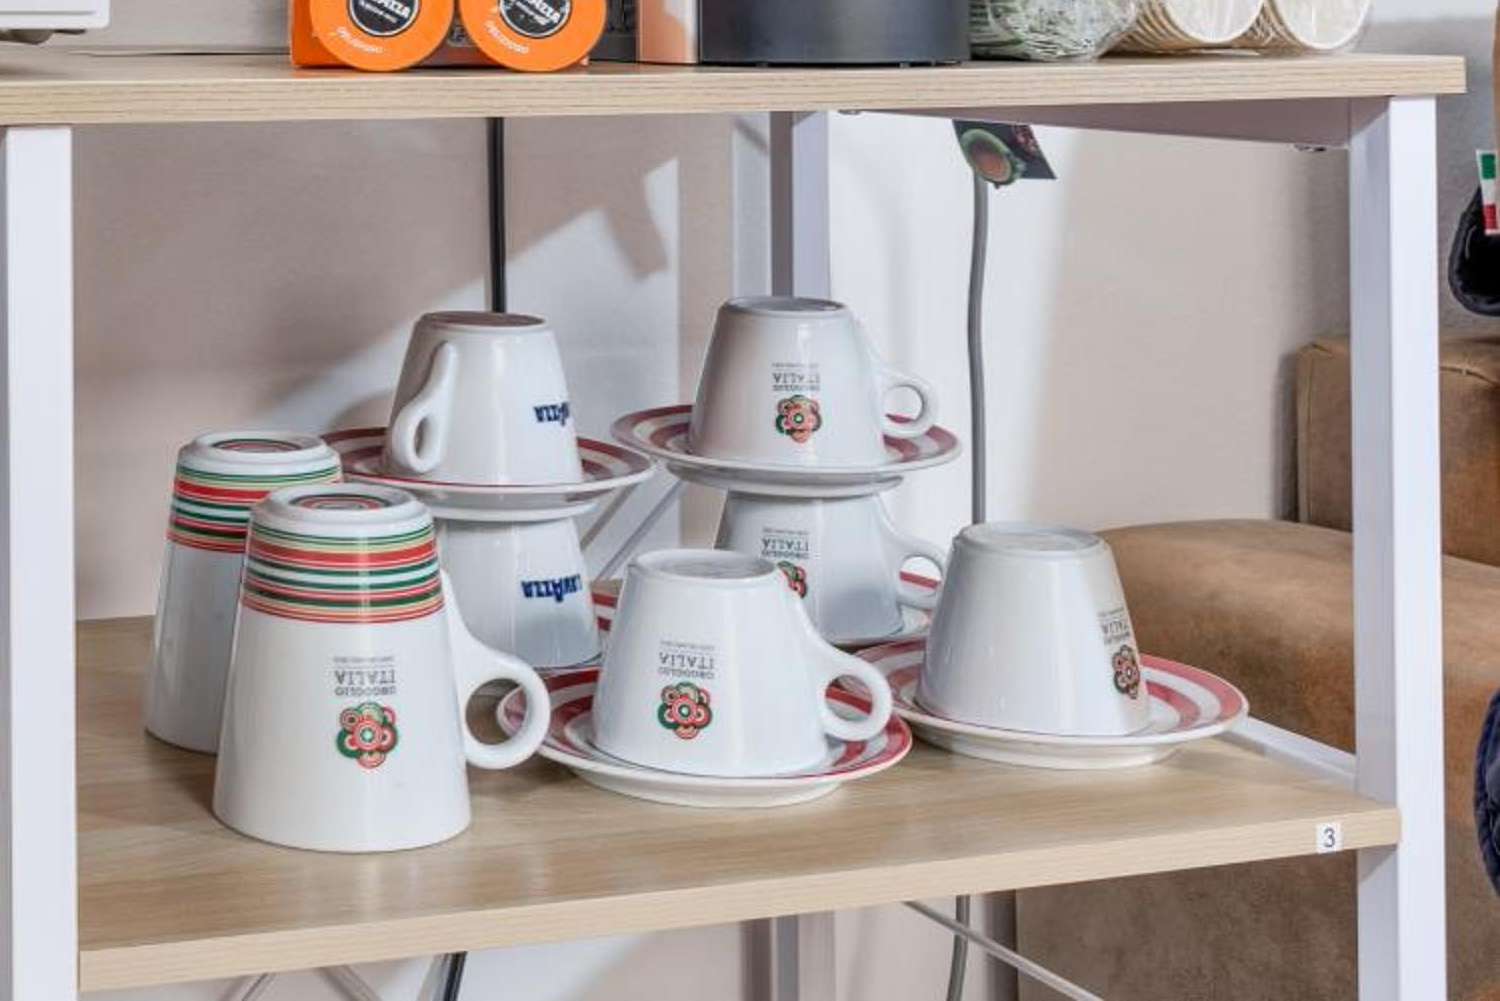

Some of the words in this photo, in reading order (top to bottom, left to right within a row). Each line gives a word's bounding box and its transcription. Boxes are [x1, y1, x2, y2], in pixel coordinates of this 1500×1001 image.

[762, 538, 809, 552] ITALIA
[659, 652, 715, 670] ITALIA
[334, 670, 396, 685] ITALIA
[1323, 827, 1336, 848] 3
